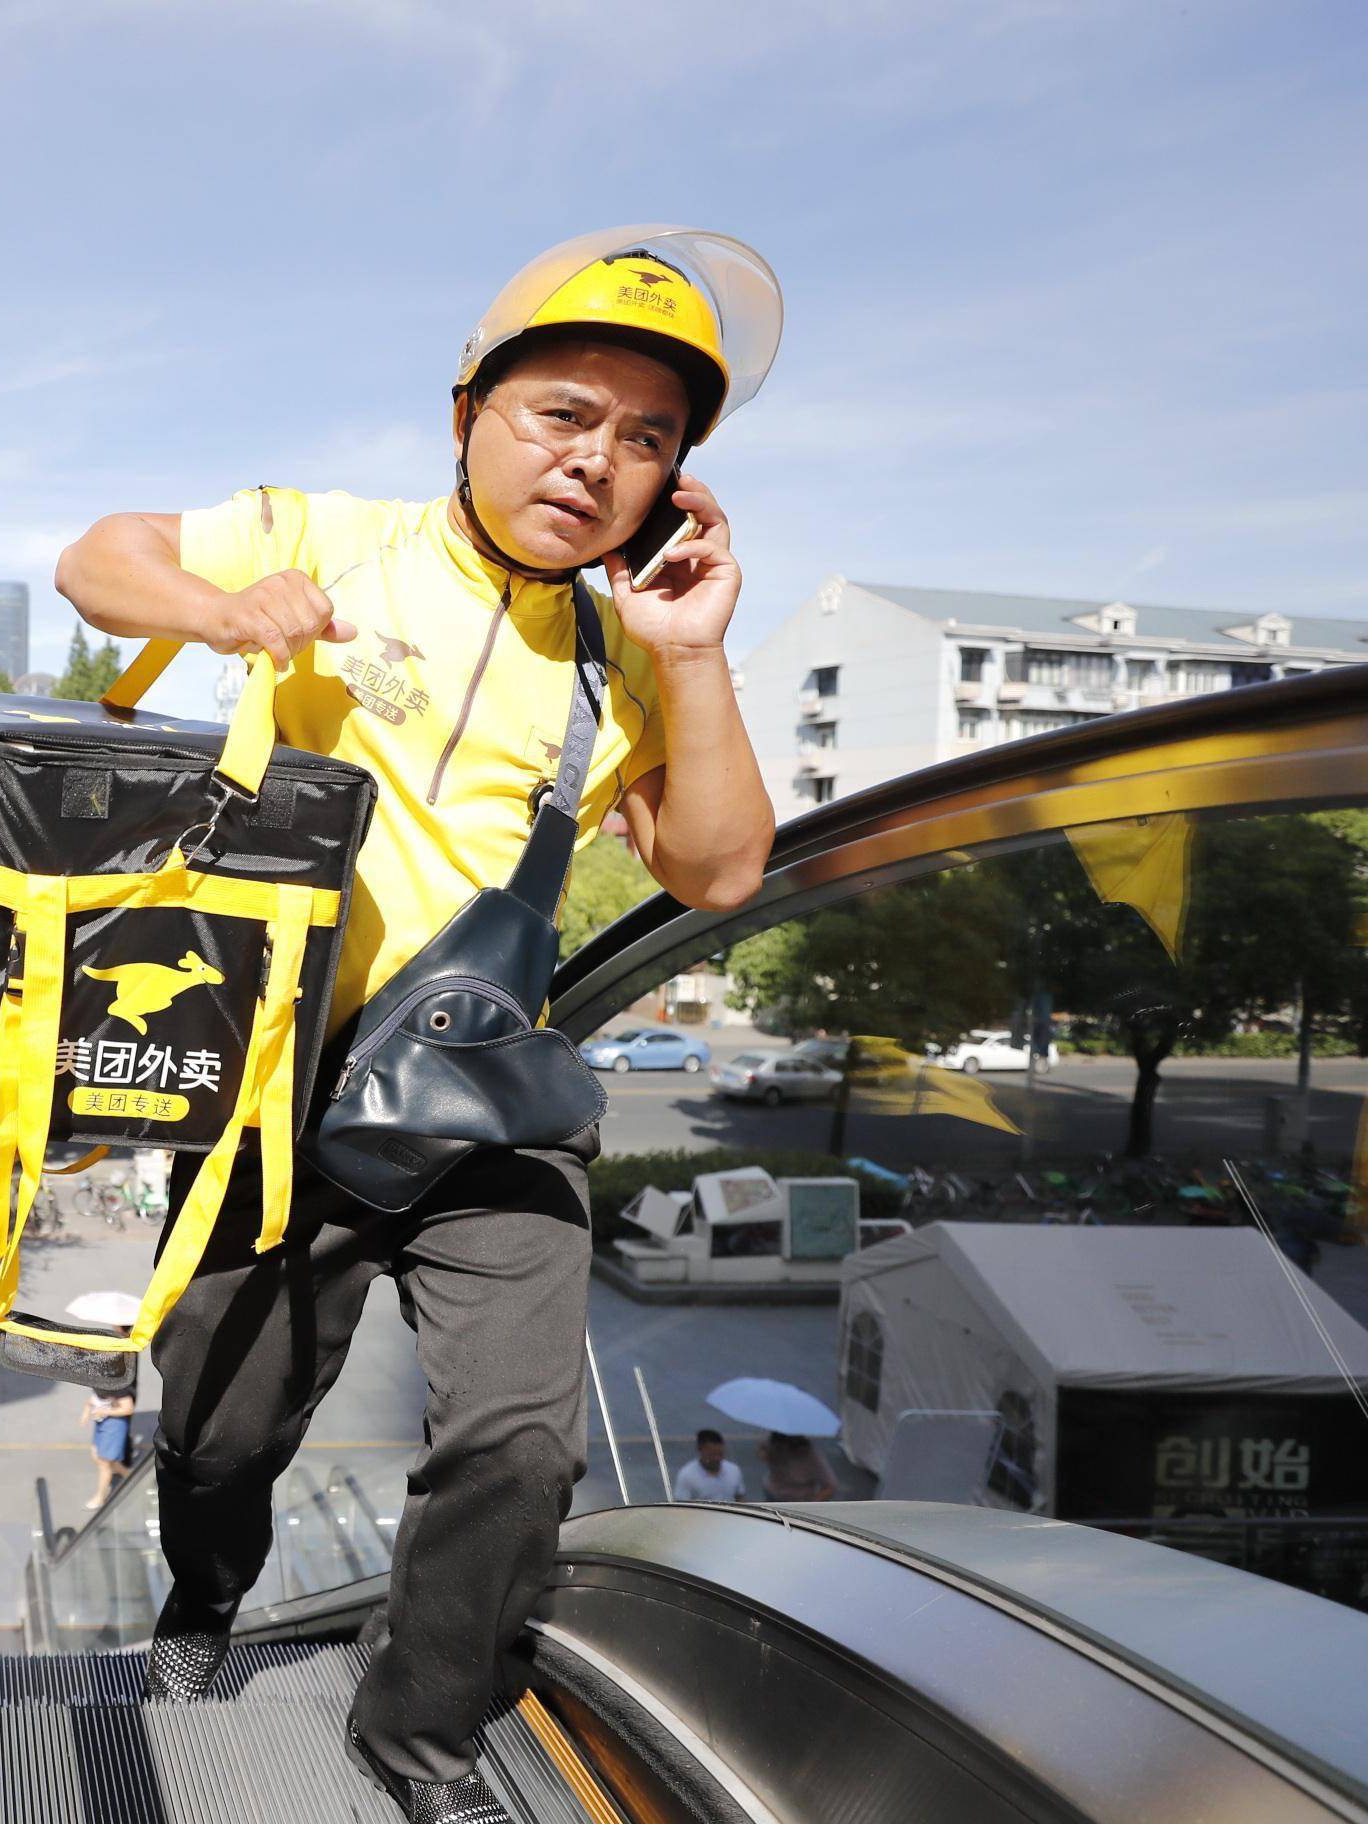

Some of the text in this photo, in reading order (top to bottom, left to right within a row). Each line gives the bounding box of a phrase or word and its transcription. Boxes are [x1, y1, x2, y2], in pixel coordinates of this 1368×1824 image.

[617, 286, 677, 313] 美团外卖
[340, 655, 430, 717] 美团外卖
[55, 1037, 222, 1093] 美团外卖
[86, 1092, 173, 1117] 美团专送
[1155, 1435, 1311, 1490] 创始
